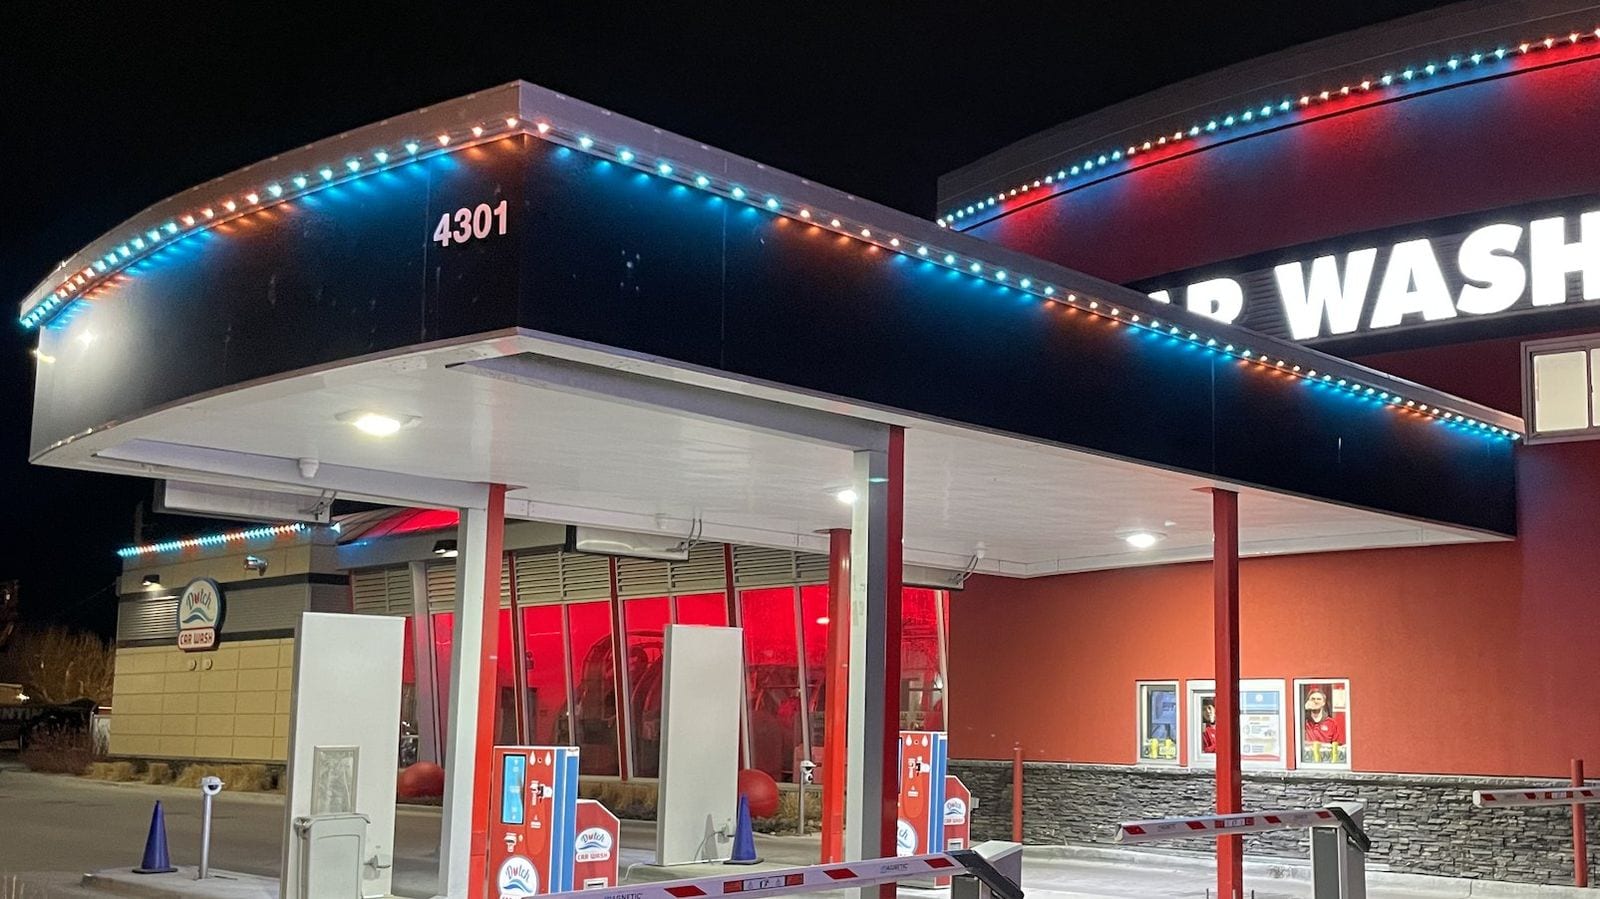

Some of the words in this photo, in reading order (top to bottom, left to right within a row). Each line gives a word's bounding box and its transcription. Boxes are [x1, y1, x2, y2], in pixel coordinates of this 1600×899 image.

[433, 200, 507, 247] 4301
[1273, 210, 1600, 341] WASH
[186, 588, 212, 610] Dutch
[180, 633, 193, 645] CAR
[194, 632, 213, 644] WASH
[581, 832, 605, 843] Dutch
[505, 864, 530, 883] Dutch
